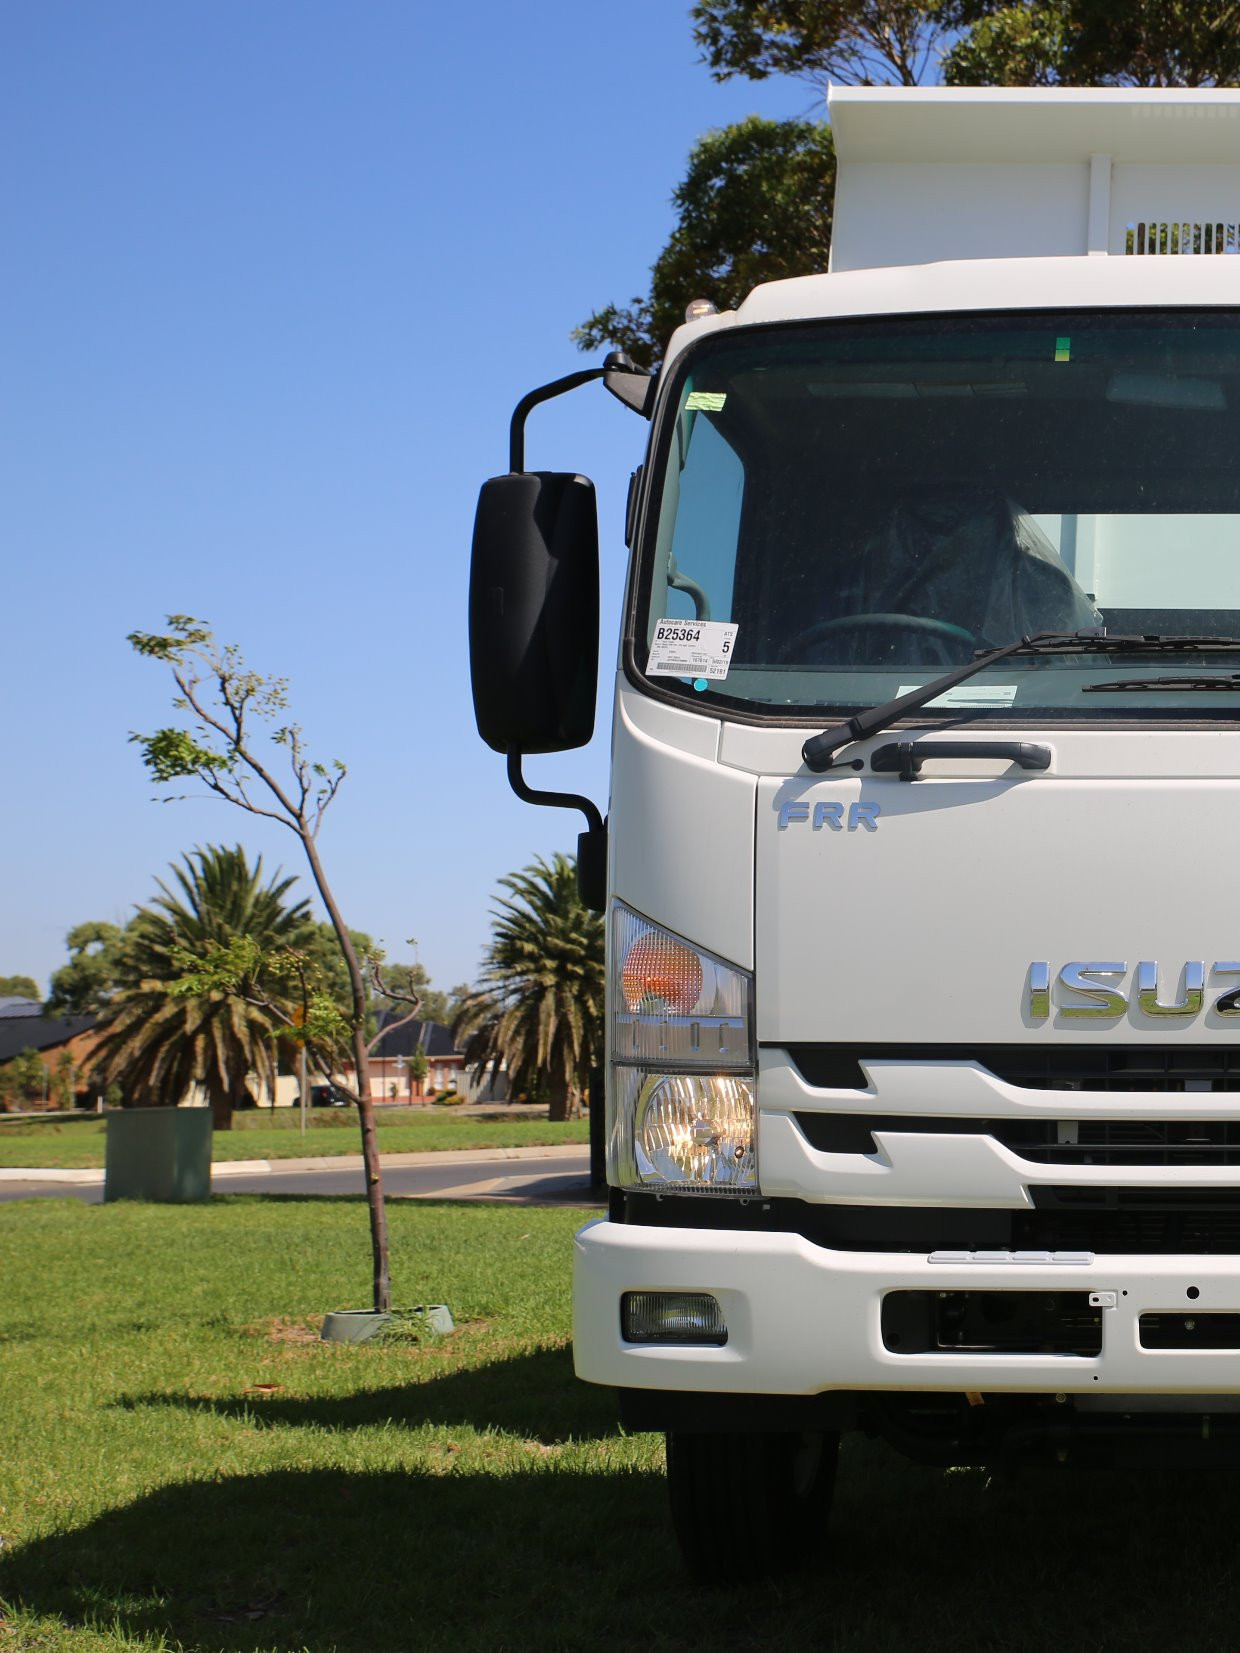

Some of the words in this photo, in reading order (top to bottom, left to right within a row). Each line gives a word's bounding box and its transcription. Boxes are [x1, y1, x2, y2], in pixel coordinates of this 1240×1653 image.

[657, 627, 701, 642] B25364
[722, 641, 731, 653] 5
[779, 801, 881, 829] FRR
